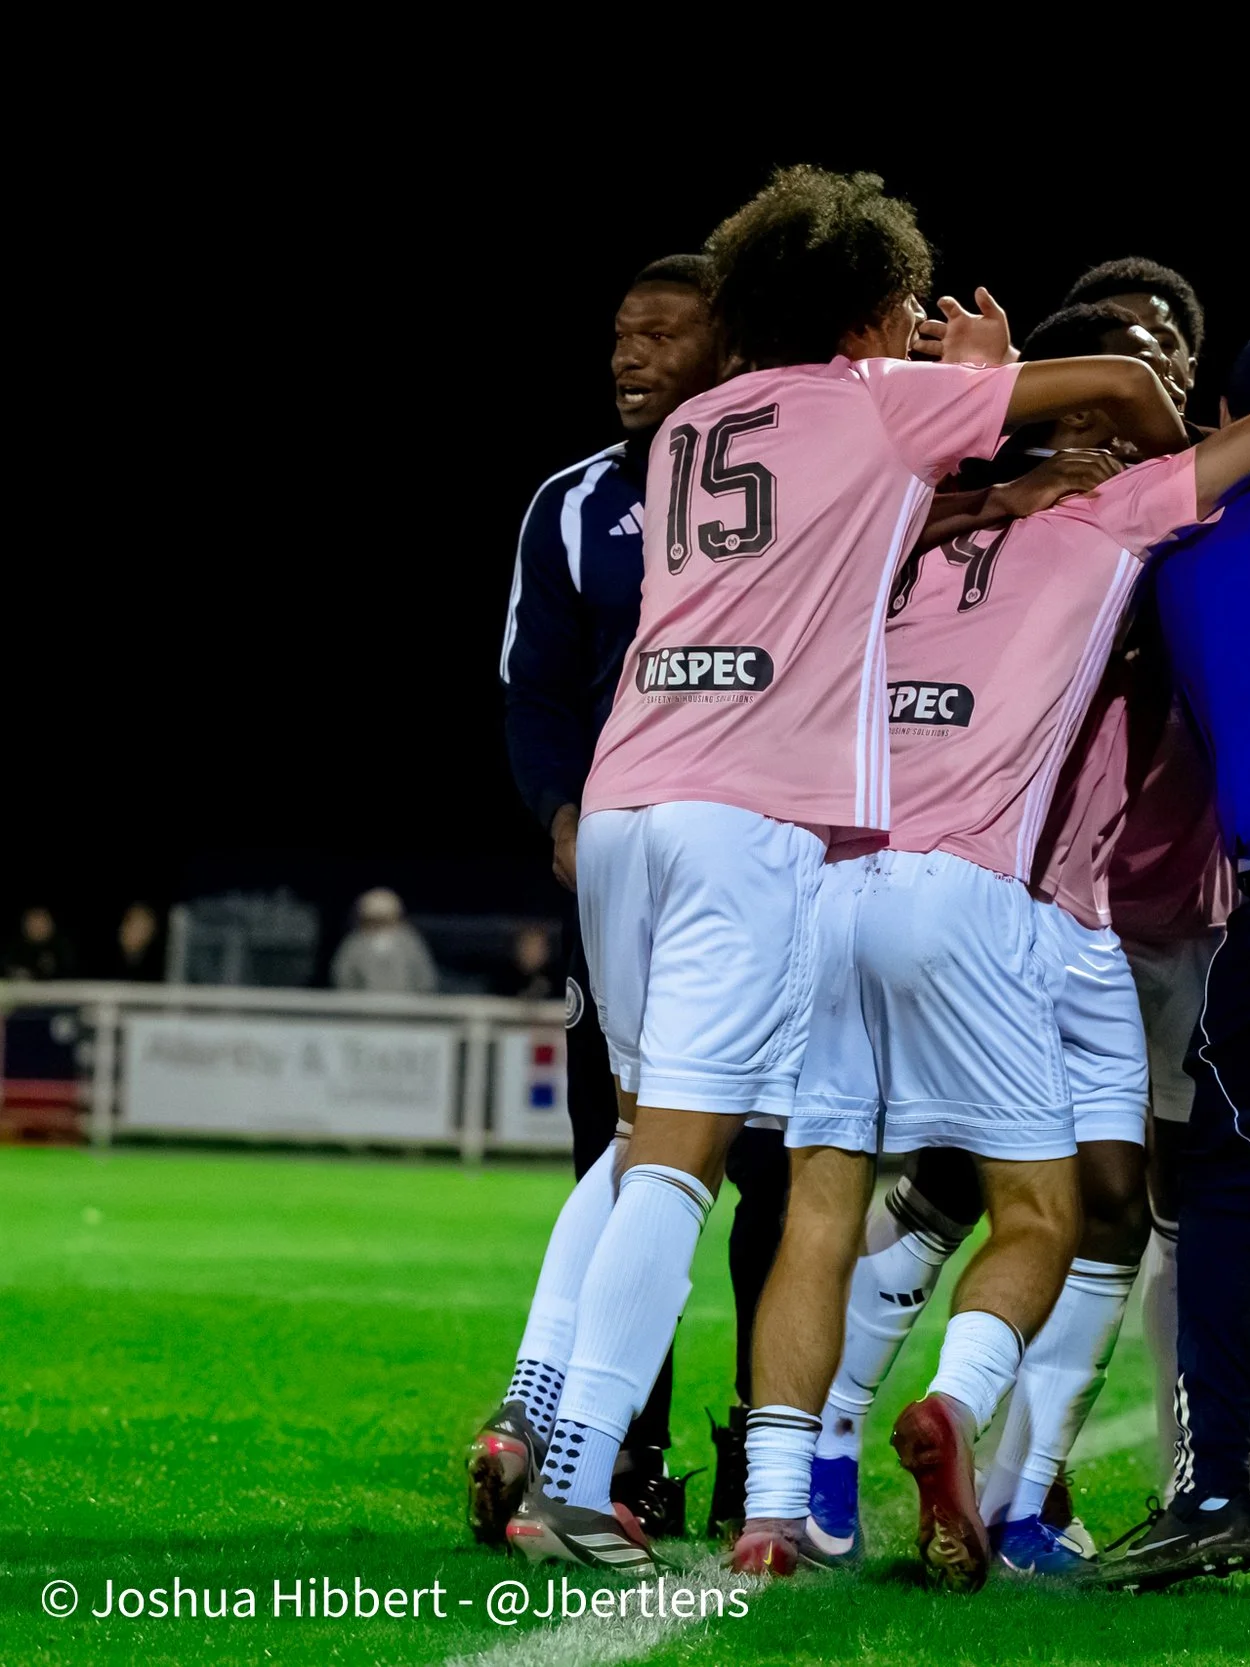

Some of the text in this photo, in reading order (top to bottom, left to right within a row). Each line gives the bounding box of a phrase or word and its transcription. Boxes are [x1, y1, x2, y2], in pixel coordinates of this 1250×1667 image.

[667, 403, 779, 575] 15
[682, 694, 714, 704] HOUSING
[912, 728, 950, 737] SOLUTIONS
